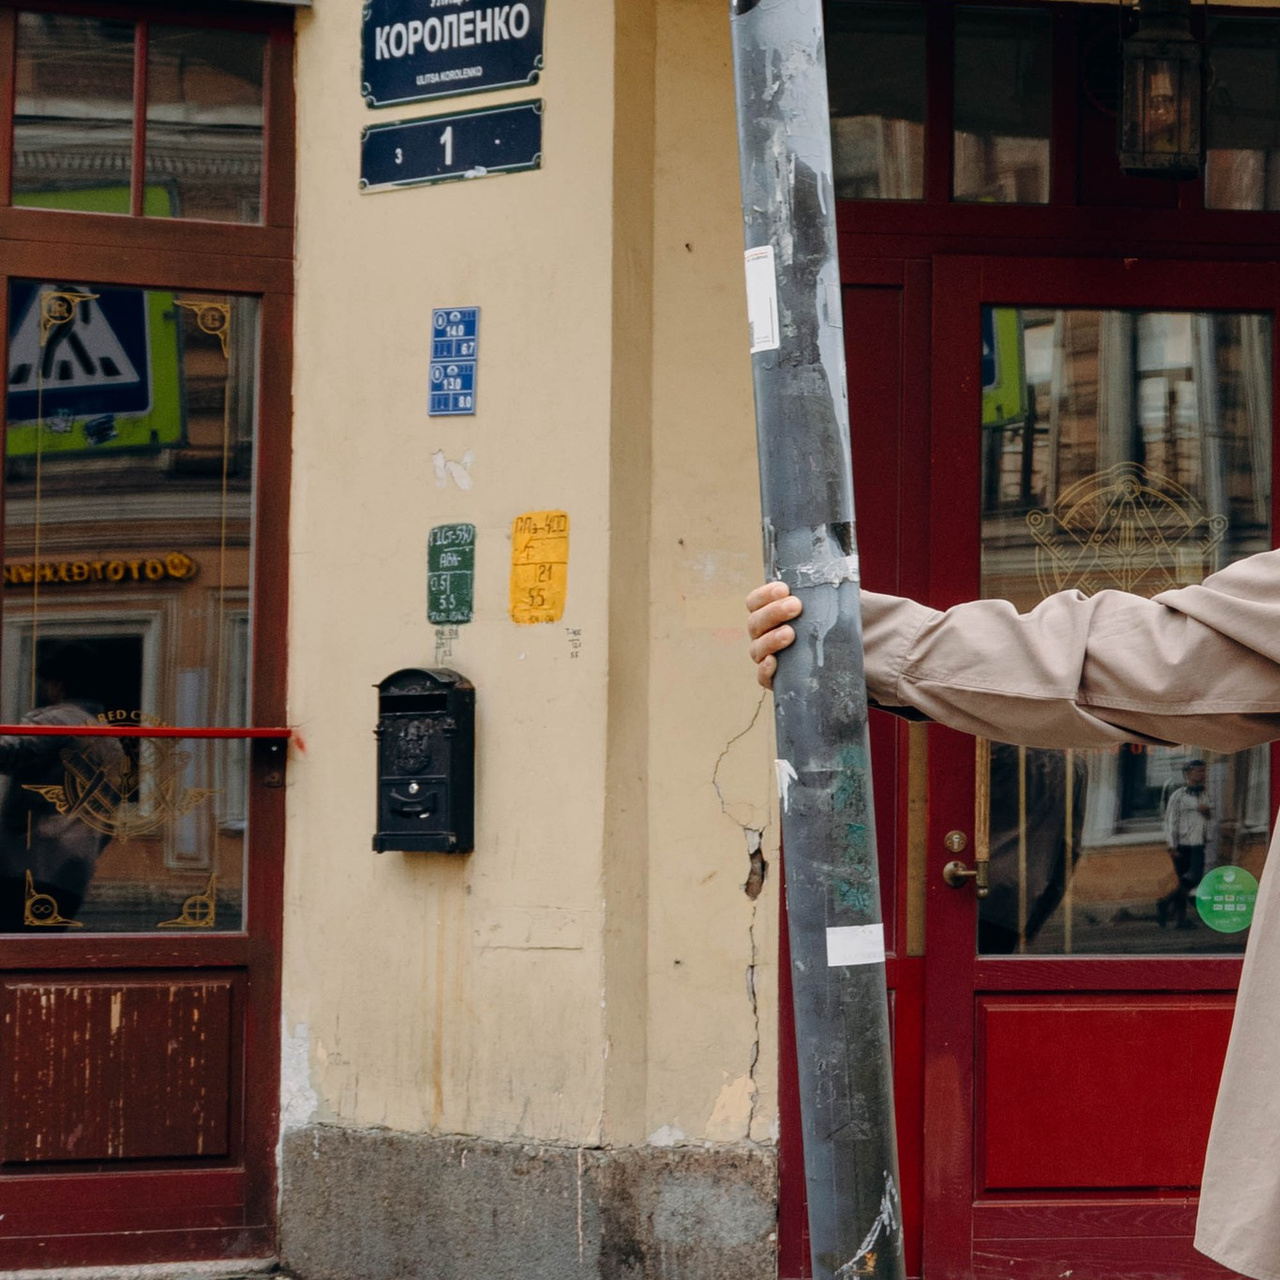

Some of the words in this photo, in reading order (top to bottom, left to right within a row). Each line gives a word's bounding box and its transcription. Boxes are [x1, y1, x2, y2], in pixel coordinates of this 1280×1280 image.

[374, 2, 531, 61] КОРОЛЕНКО
[415, 72, 440, 86] ULITSA
[440, 65, 483, 82] KOROLENKO
[440, 126, 453, 166] 1
